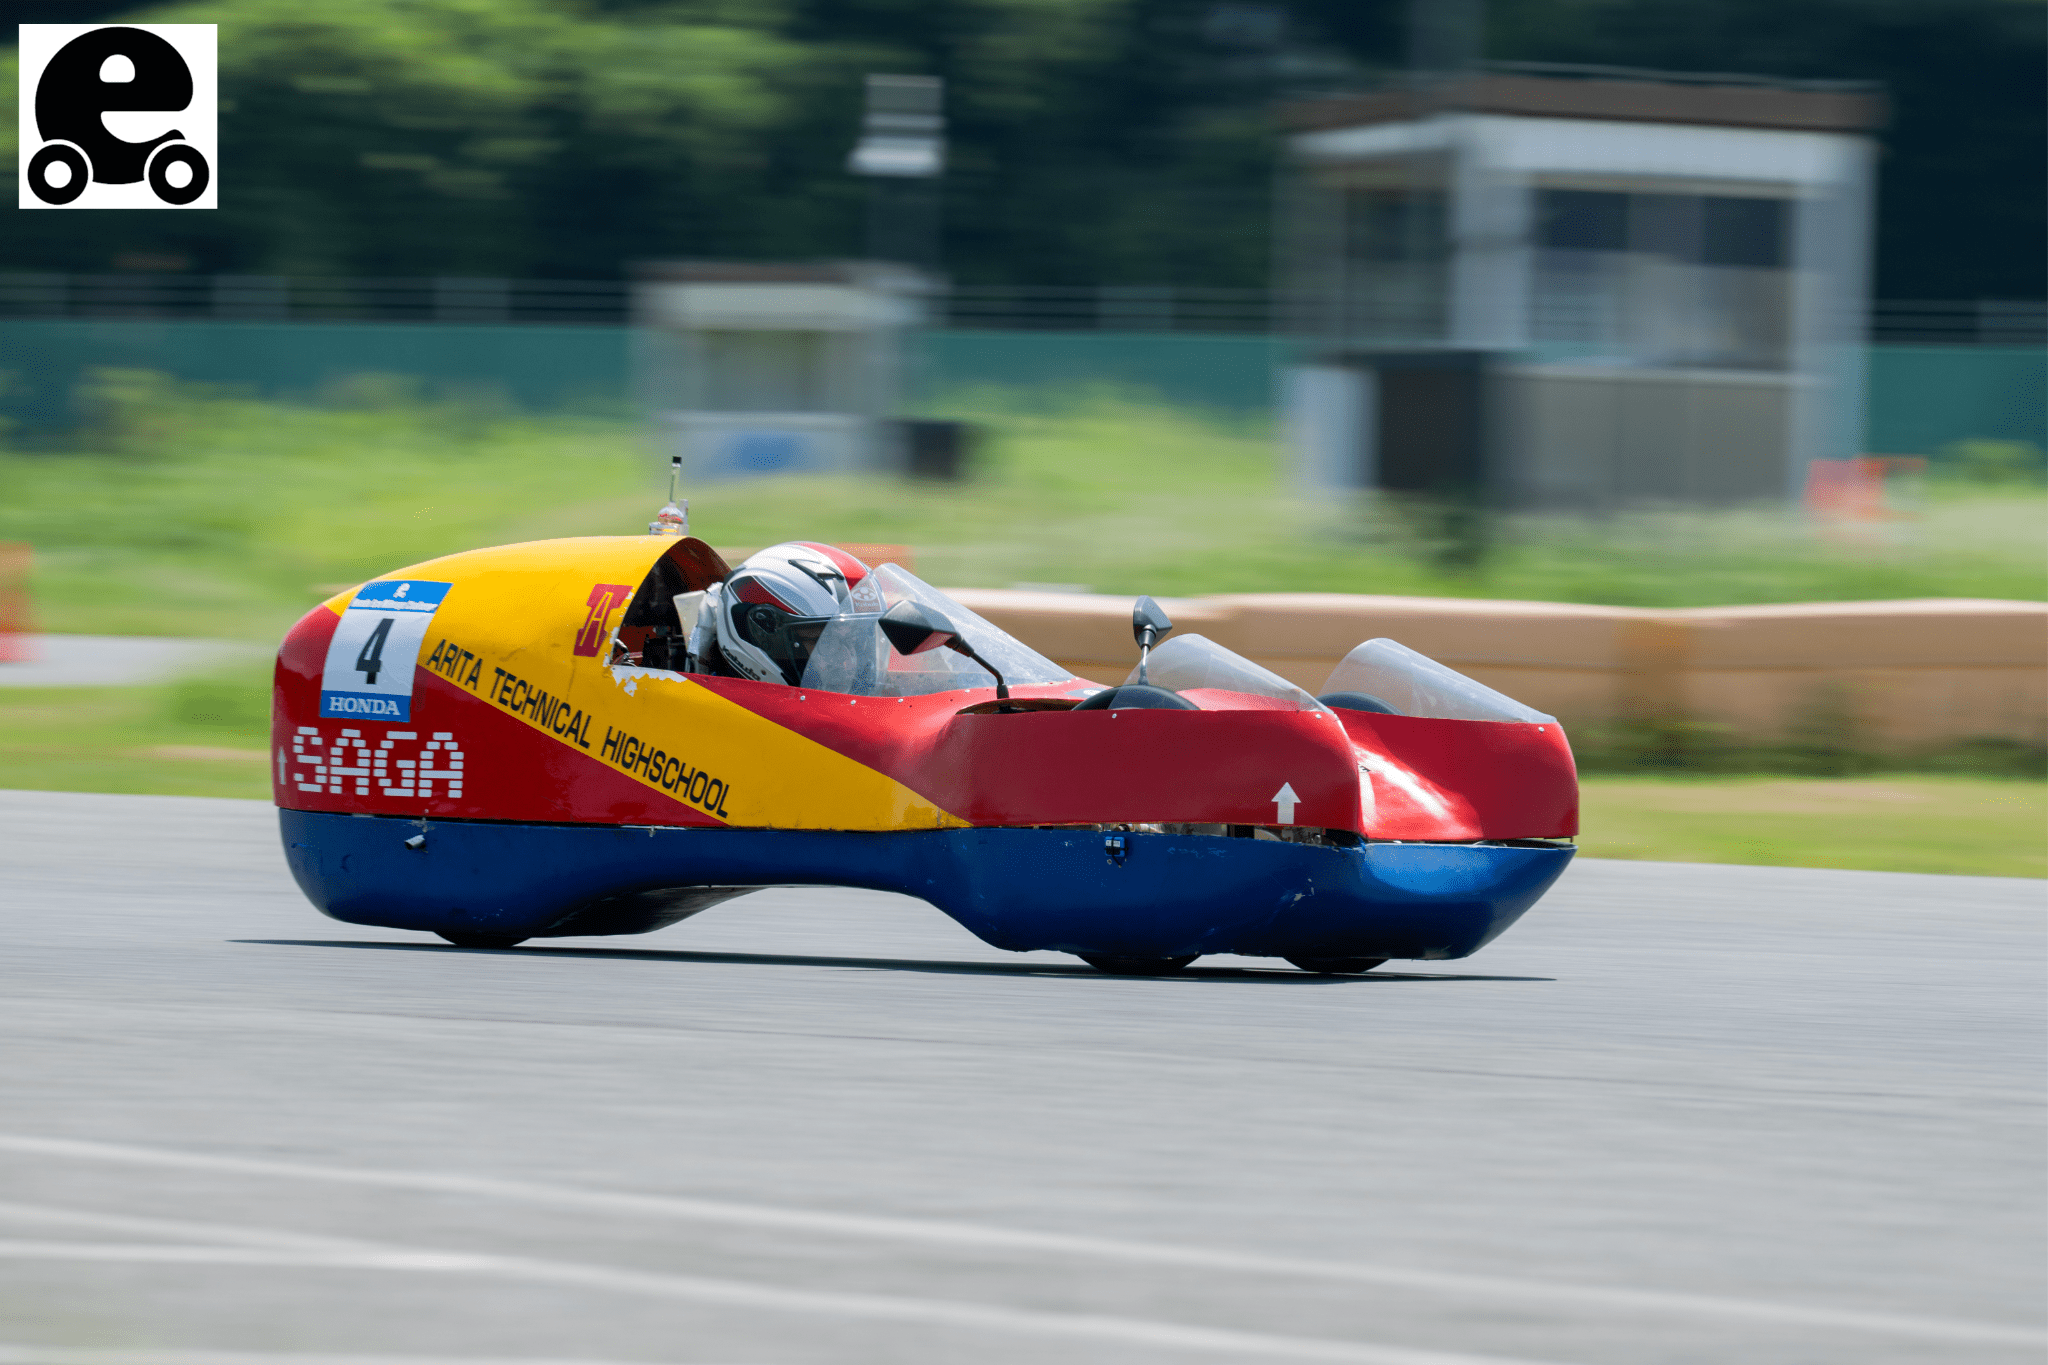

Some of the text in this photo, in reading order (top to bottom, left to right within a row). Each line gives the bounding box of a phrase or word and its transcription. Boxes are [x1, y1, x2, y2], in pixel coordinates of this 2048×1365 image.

[355, 618, 395, 685] 4
[328, 696, 401, 716] HONDA
[426, 638, 731, 819] ARITA TECHNICAL HIGHSCHOOL
[293, 726, 464, 798] SAGA
